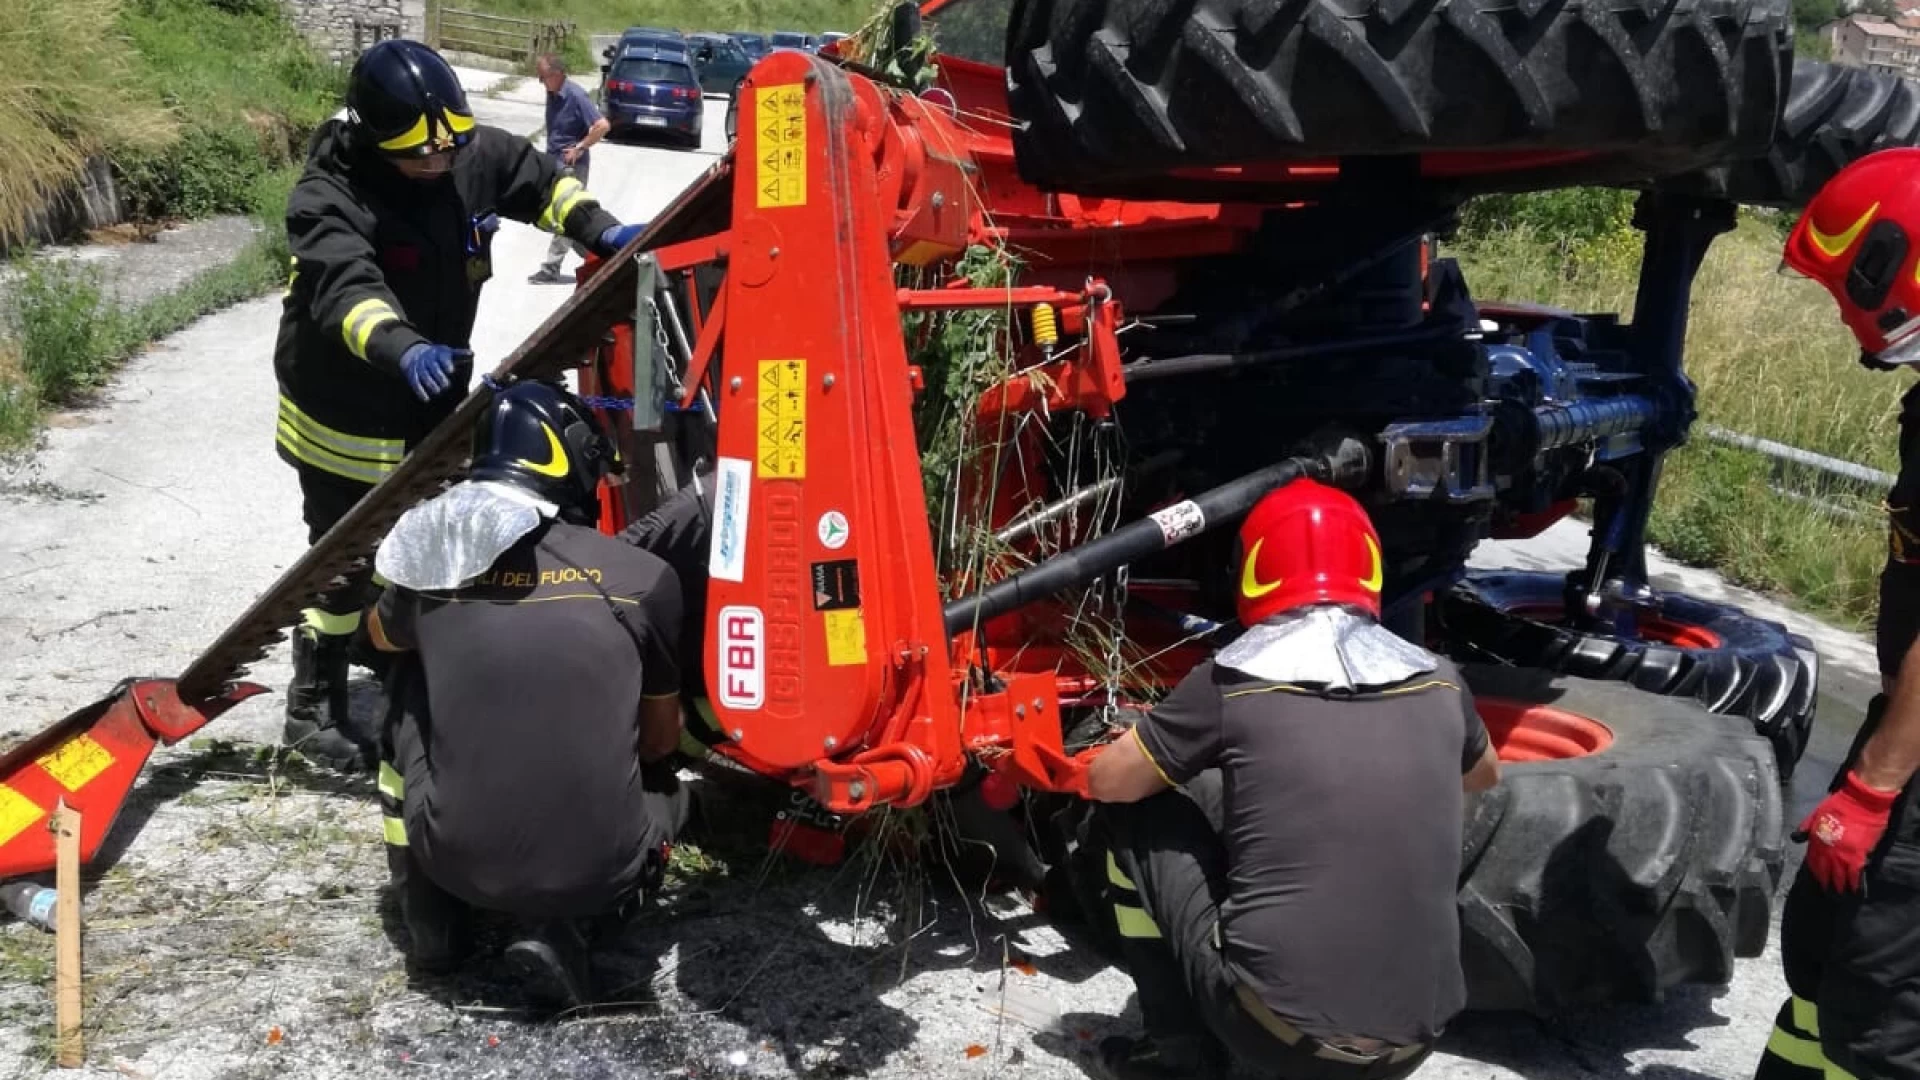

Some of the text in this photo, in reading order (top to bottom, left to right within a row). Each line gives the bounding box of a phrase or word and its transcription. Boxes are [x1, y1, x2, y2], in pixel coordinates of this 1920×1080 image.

[503, 571, 536, 587] DEL
[767, 494, 799, 704] GASPARDO
[728, 616, 755, 698] FBR
